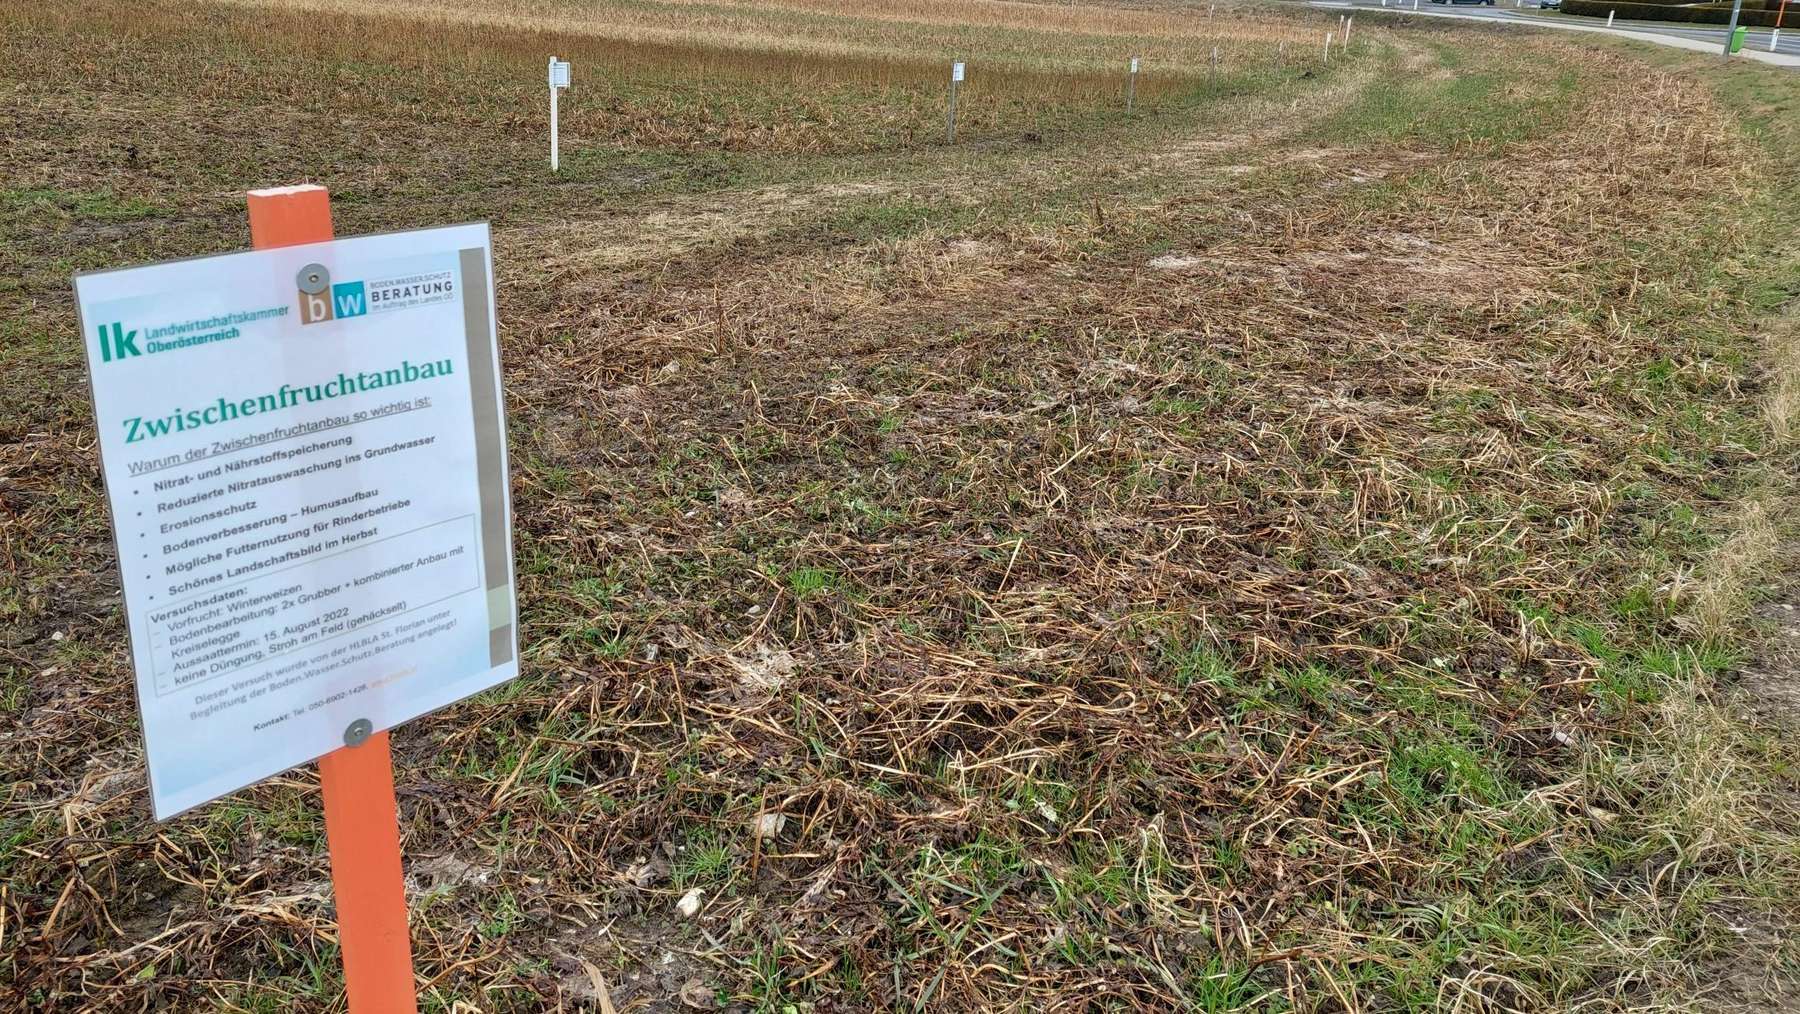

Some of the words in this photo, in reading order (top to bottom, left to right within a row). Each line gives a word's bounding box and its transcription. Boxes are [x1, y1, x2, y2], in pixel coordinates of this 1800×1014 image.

[371, 281, 453, 302] BERATUNG
[98, 322, 142, 362] lk
[144, 305, 289, 340] Landwirtschaftskammer
[146, 328, 240, 354] Oberösterreich
[122, 359, 454, 443] Zwischenfruchtanbau
[127, 454, 181, 474] Warum
[185, 446, 207, 461] der
[211, 414, 350, 455] Zwischenfruchtanbau
[353, 410, 367, 420] so
[370, 400, 412, 417] wichtig
[415, 396, 432, 407] ist:
[153, 475, 194, 492] Nitrat-
[197, 467, 222, 480] und
[225, 436, 353, 473] Nährstoffspeicherung
[157, 487, 225, 513] Reduzierte
[228, 458, 342, 494] Nitratauswaschung
[345, 453, 362, 464] ins
[364, 435, 436, 459] Grundwasser
[160, 501, 257, 534] Erosionsschutz
[163, 513, 288, 555] Bodenverbesserung
[301, 488, 379, 516] Humusaufbau
[165, 554, 223, 576] Mögliche
[226, 527, 310, 557] Futternutzung
[313, 522, 329, 533] für
[332, 499, 411, 528] Rinderbetriebe
[169, 574, 223, 596] Schönes
[227, 543, 322, 578] Landschaftsbild
[325, 540, 339, 550] im
[342, 528, 378, 545] Herbst
[151, 586, 248, 624] Versuchsdaten:
[168, 608, 224, 632] Vorfrucht:
[227, 584, 302, 613] Winterweizen
[169, 605, 278, 646] Bodenbearbeitung:
[282, 600, 295, 611] 2x
[298, 584, 341, 605] Grubber
[353, 561, 414, 587] kombinierter
[416, 550, 447, 567] Anbau
[450, 545, 464, 557] mit
[171, 630, 240, 659] Kreiselegge
[173, 638, 260, 672] Aussaattermin:
[264, 631, 280, 642] 15.
[282, 617, 320, 636] August
[323, 607, 349, 623] 2022
[174, 669, 207, 686] keine
[269, 638, 298, 654] Stroh
[301, 632, 318, 643] am
[321, 622, 344, 636] Feld
[346, 600, 407, 630] (gehäckselt)
[195, 687, 229, 704] Dieser
[232, 672, 273, 691] Versuch
[275, 660, 308, 676] wurde
[310, 654, 329, 665] von
[331, 647, 347, 658] der
[350, 635, 379, 650] HLBLA
[381, 630, 393, 640] St.
[395, 618, 426, 635] Florian
[427, 610, 451, 623] unter
[190, 695, 248, 721] Begleitung
[249, 688, 267, 699] der
[254, 713, 290, 732] Kontakt:
